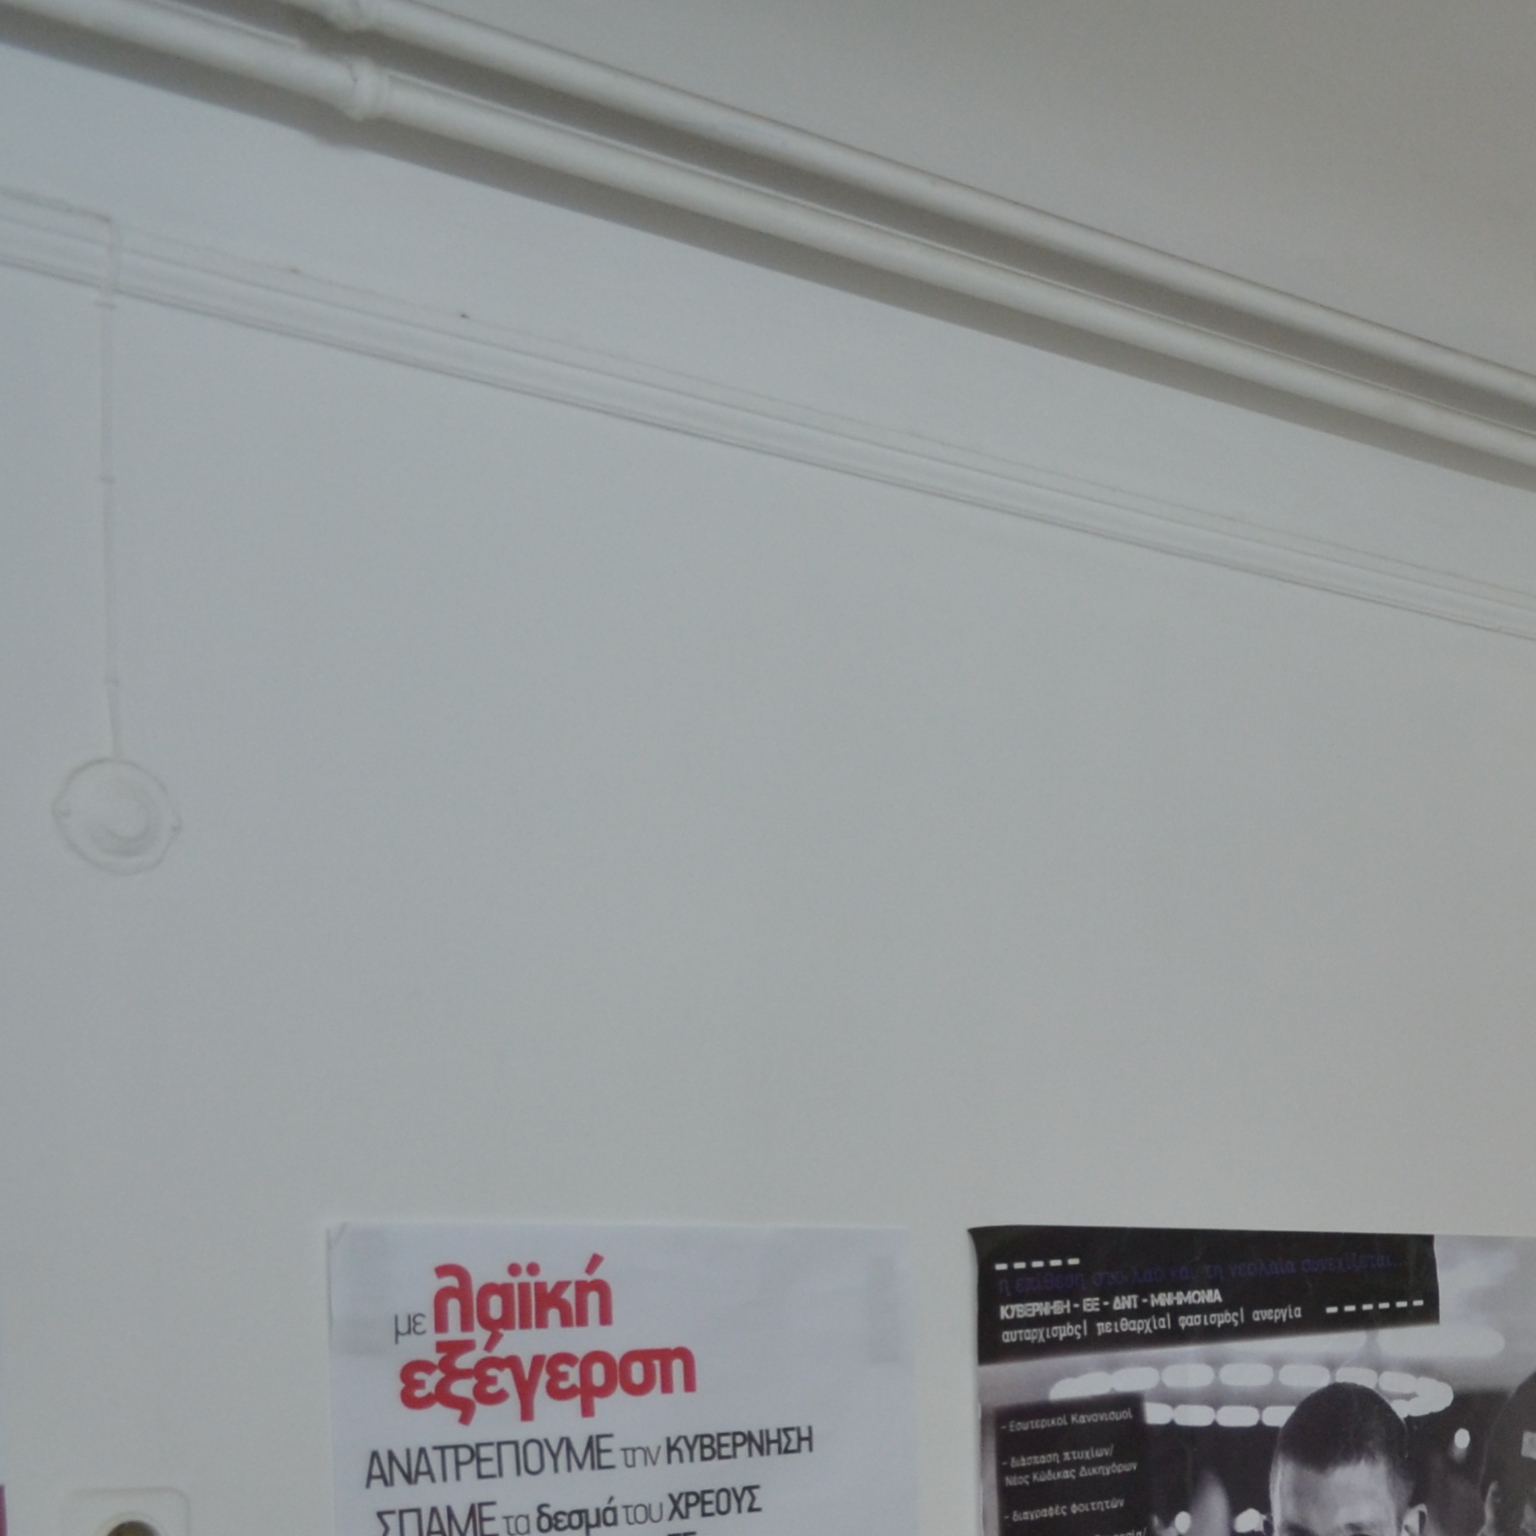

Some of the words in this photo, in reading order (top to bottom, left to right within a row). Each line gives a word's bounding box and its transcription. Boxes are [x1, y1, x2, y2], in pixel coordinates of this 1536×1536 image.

[394, 1310, 427, 1344] με
[433, 1252, 613, 1334] λαϊκή
[1113, 1294, 1138, 1311] ΔΝΤ
[400, 1330, 698, 1426] εξέγερση
[365, 1433, 616, 1489] ΑΝΑΤΡΕΠΟΥΜΕ
[620, 1443, 662, 1469] την
[666, 1425, 814, 1467] ΚΥΒΕΡΝΗΣΗ
[502, 1511, 530, 1536] τα
[621, 1504, 664, 1528] του
[667, 1485, 763, 1523] ΧΡΕΟΥΣ
